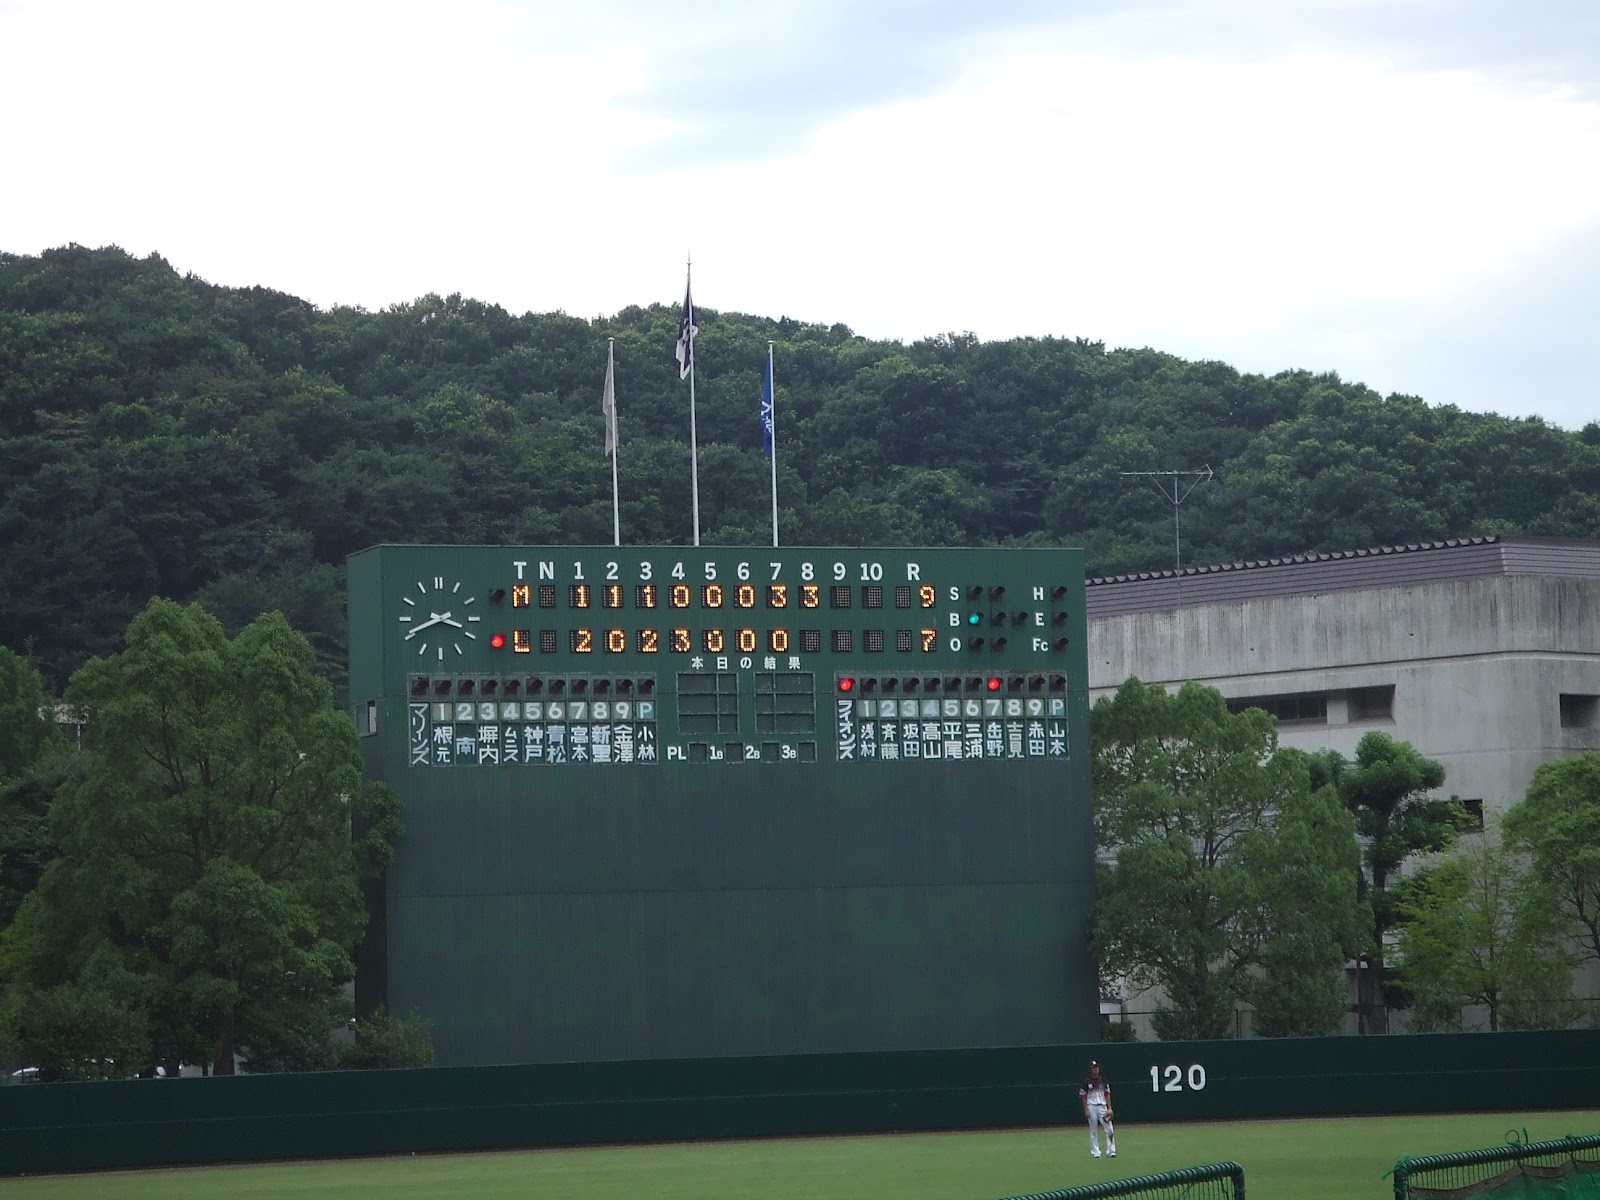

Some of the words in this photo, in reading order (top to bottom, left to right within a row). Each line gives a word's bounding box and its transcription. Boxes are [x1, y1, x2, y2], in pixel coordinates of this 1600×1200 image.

[513, 561, 527, 580] T
[539, 561, 555, 580] N
[574, 561, 584, 580] 1
[605, 561, 619, 580] 2
[639, 562, 653, 580] 3
[671, 562, 685, 580] 4
[704, 562, 717, 581] 5
[736, 562, 751, 581] 6
[769, 562, 782, 581] 7
[801, 562, 815, 581] 8
[833, 562, 846, 581] 9
[860, 562, 883, 581] 10
[907, 563, 921, 581] R
[512, 584, 530, 608] M
[576, 585, 588, 608] 1
[610, 585, 621, 608] 1
[673, 585, 690, 608] 0
[738, 585, 755, 608] 0
[770, 585, 787, 608] 3
[802, 585, 819, 608] 3
[919, 585, 935, 608] 9
[949, 587, 960, 601] S
[1033, 587, 1044, 600] H
[949, 613, 960, 627] B
[1035, 613, 1045, 626] E
[513, 630, 530, 653] L
[575, 629, 592, 653] 2
[641, 629, 658, 653] 2
[674, 629, 691, 652] 3
[739, 629, 756, 652] 0
[772, 629, 788, 652] 0
[920, 629, 937, 652] 7
[691, 656, 801, 670] 本日の結果
[438, 703, 445, 721] 1
[457, 703, 473, 721] 2
[481, 702, 495, 721] 3
[503, 702, 519, 720] 4
[525, 702, 541, 720] 5
[548, 702, 563, 720] 6
[570, 702, 585, 720] 7
[593, 702, 608, 720] 8
[615, 702, 629, 719] 9
[639, 702, 652, 719] P
[863, 700, 870, 717] 1
[881, 700, 895, 717] 2
[903, 700, 917, 717] 3
[924, 700, 938, 717] 4
[944, 700, 959, 717] 5
[966, 699, 979, 716] 6
[986, 699, 1001, 716] 7
[1008, 699, 1021, 716] 8
[1028, 699, 1042, 716] 9
[1052, 700, 1064, 715] P
[433, 726, 453, 763] 根元
[456, 736, 476, 755] 南
[503, 727, 519, 762] ムニス
[524, 725, 544, 763] 神戸
[546, 724, 566, 764] 青松
[613, 724, 634, 763] 金澤
[637, 726, 655, 761] 小林
[667, 746, 687, 760] PL
[860, 722, 877, 758] 浅村
[903, 723, 920, 758] 坂田
[922, 722, 942, 759] 高山
[942, 722, 963, 759] 平尾
[965, 723, 983, 759] 三浦
[1007, 721, 1025, 759] 吉見
[1028, 721, 1045, 756] 赤田
[1049, 722, 1066, 756] 山本
[1150, 1064, 1207, 1092] 120
